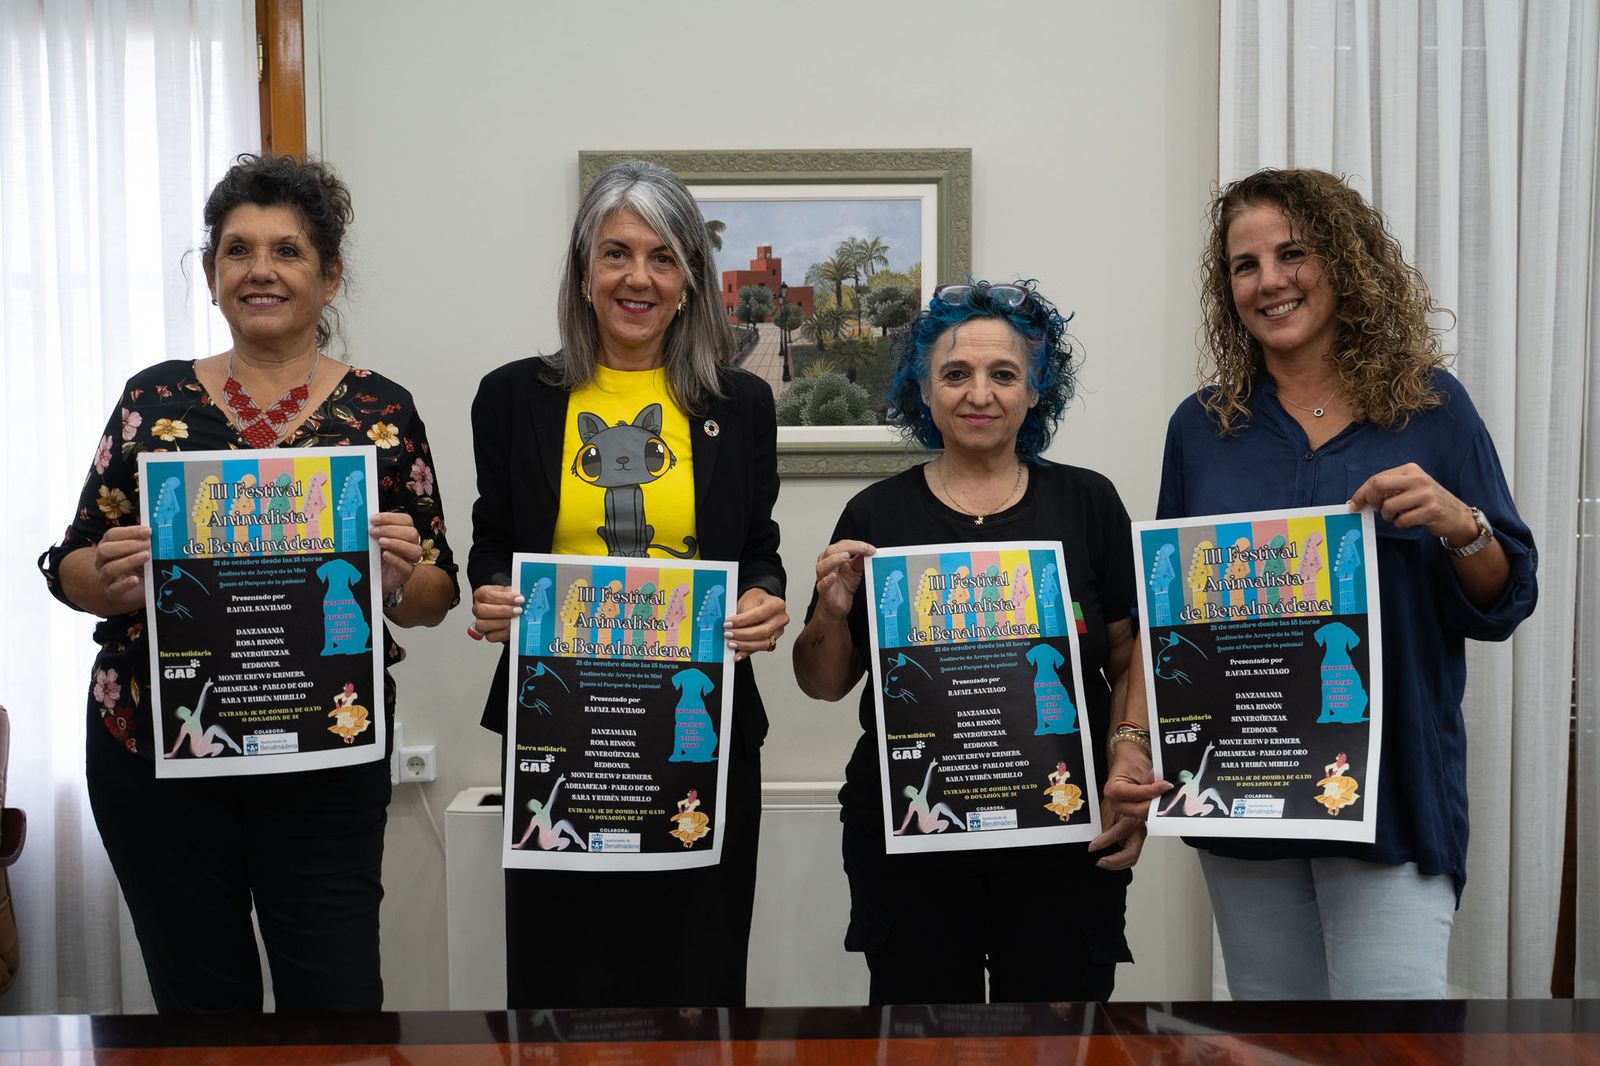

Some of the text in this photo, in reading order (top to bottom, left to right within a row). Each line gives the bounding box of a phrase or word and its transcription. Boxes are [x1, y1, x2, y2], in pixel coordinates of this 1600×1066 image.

[208, 480, 302, 499] III Festival
[207, 510, 307, 527] Animalista
[182, 534, 334, 555] de Benalmádena
[1202, 542, 1297, 564] III Festival
[928, 571, 1009, 590] III Festival
[1203, 573, 1303, 592] Animalista
[231, 593, 271, 601] Presentado
[577, 587, 665, 605] III Festival
[928, 599, 1014, 616] Animalista
[1179, 596, 1331, 620] de Benalmádena
[573, 613, 667, 630] Animalista
[236, 627, 284, 635] DANZAMANIA
[906, 620, 1039, 642] de Benalmádena
[256, 637, 284, 645] RINCÓN
[181, 649, 211, 657] solidaria
[548, 638, 691, 657] de Benalmádena
[1229, 657, 1269, 665] Presentado
[164, 667, 195, 679] GAB
[952, 676, 987, 685] Presentado
[212, 684, 258, 693] ADRIASEKAS
[974, 686, 1006, 694] SANTIAGO
[957, 708, 1000, 717] DANZAMANIA
[1160, 713, 1212, 723] Barra solidaria
[976, 718, 1001, 726] RINCÓN
[887, 730, 935, 740] Barra solidaria
[1165, 731, 1196, 744] GAB
[892, 749, 921, 760] GAB
[520, 762, 550, 772] GAB
[937, 763, 978, 772] ADRIASEKAS
